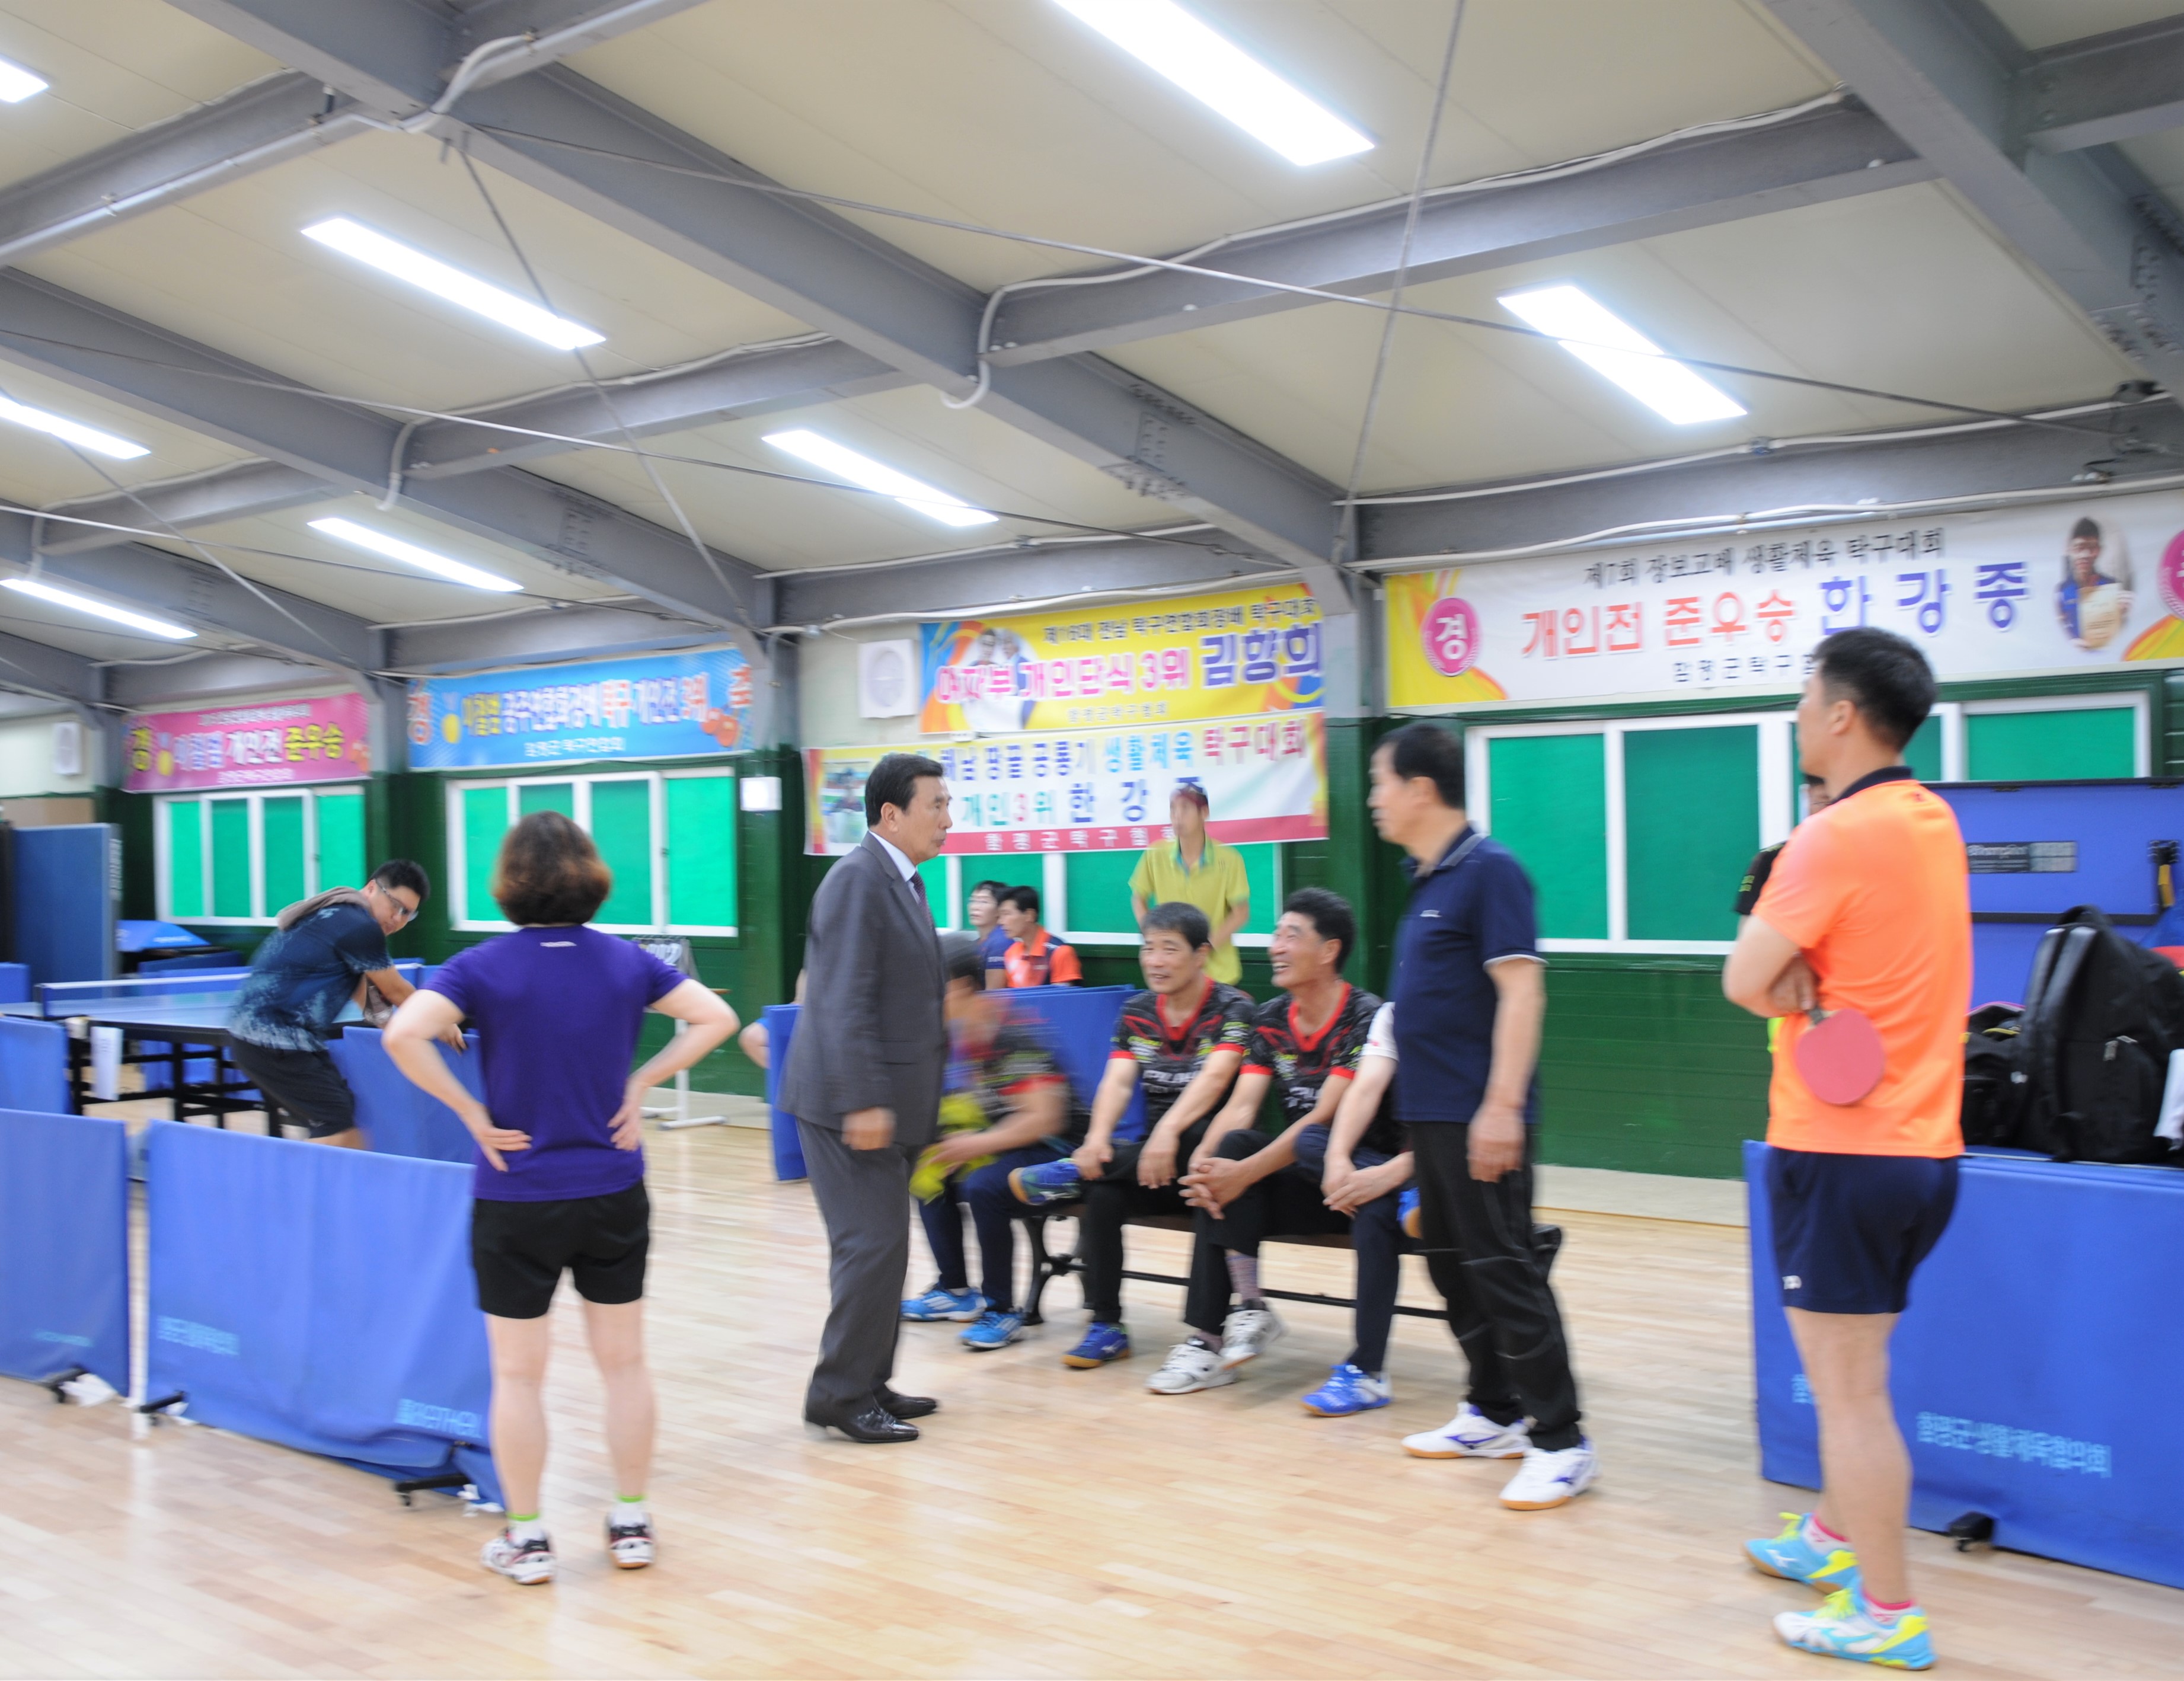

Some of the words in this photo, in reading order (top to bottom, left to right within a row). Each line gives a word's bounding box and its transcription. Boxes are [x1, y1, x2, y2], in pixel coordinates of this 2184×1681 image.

[1585, 558, 1639, 589] 제7회
[1744, 538, 1838, 574] 생활체육
[1845, 526, 1946, 561] 탁구대회
[1140, 648, 1190, 690] 3위
[1200, 621, 1322, 689] 김향희
[1435, 613, 1468, 660] 경
[1522, 602, 1644, 659] 개인전
[1665, 590, 1797, 647] 준우승
[285, 722, 345, 762] 준우승
[985, 741, 1022, 780] 땅끝
[1103, 730, 1196, 774] 생활체육
[1203, 718, 1307, 765] 탁구대회
